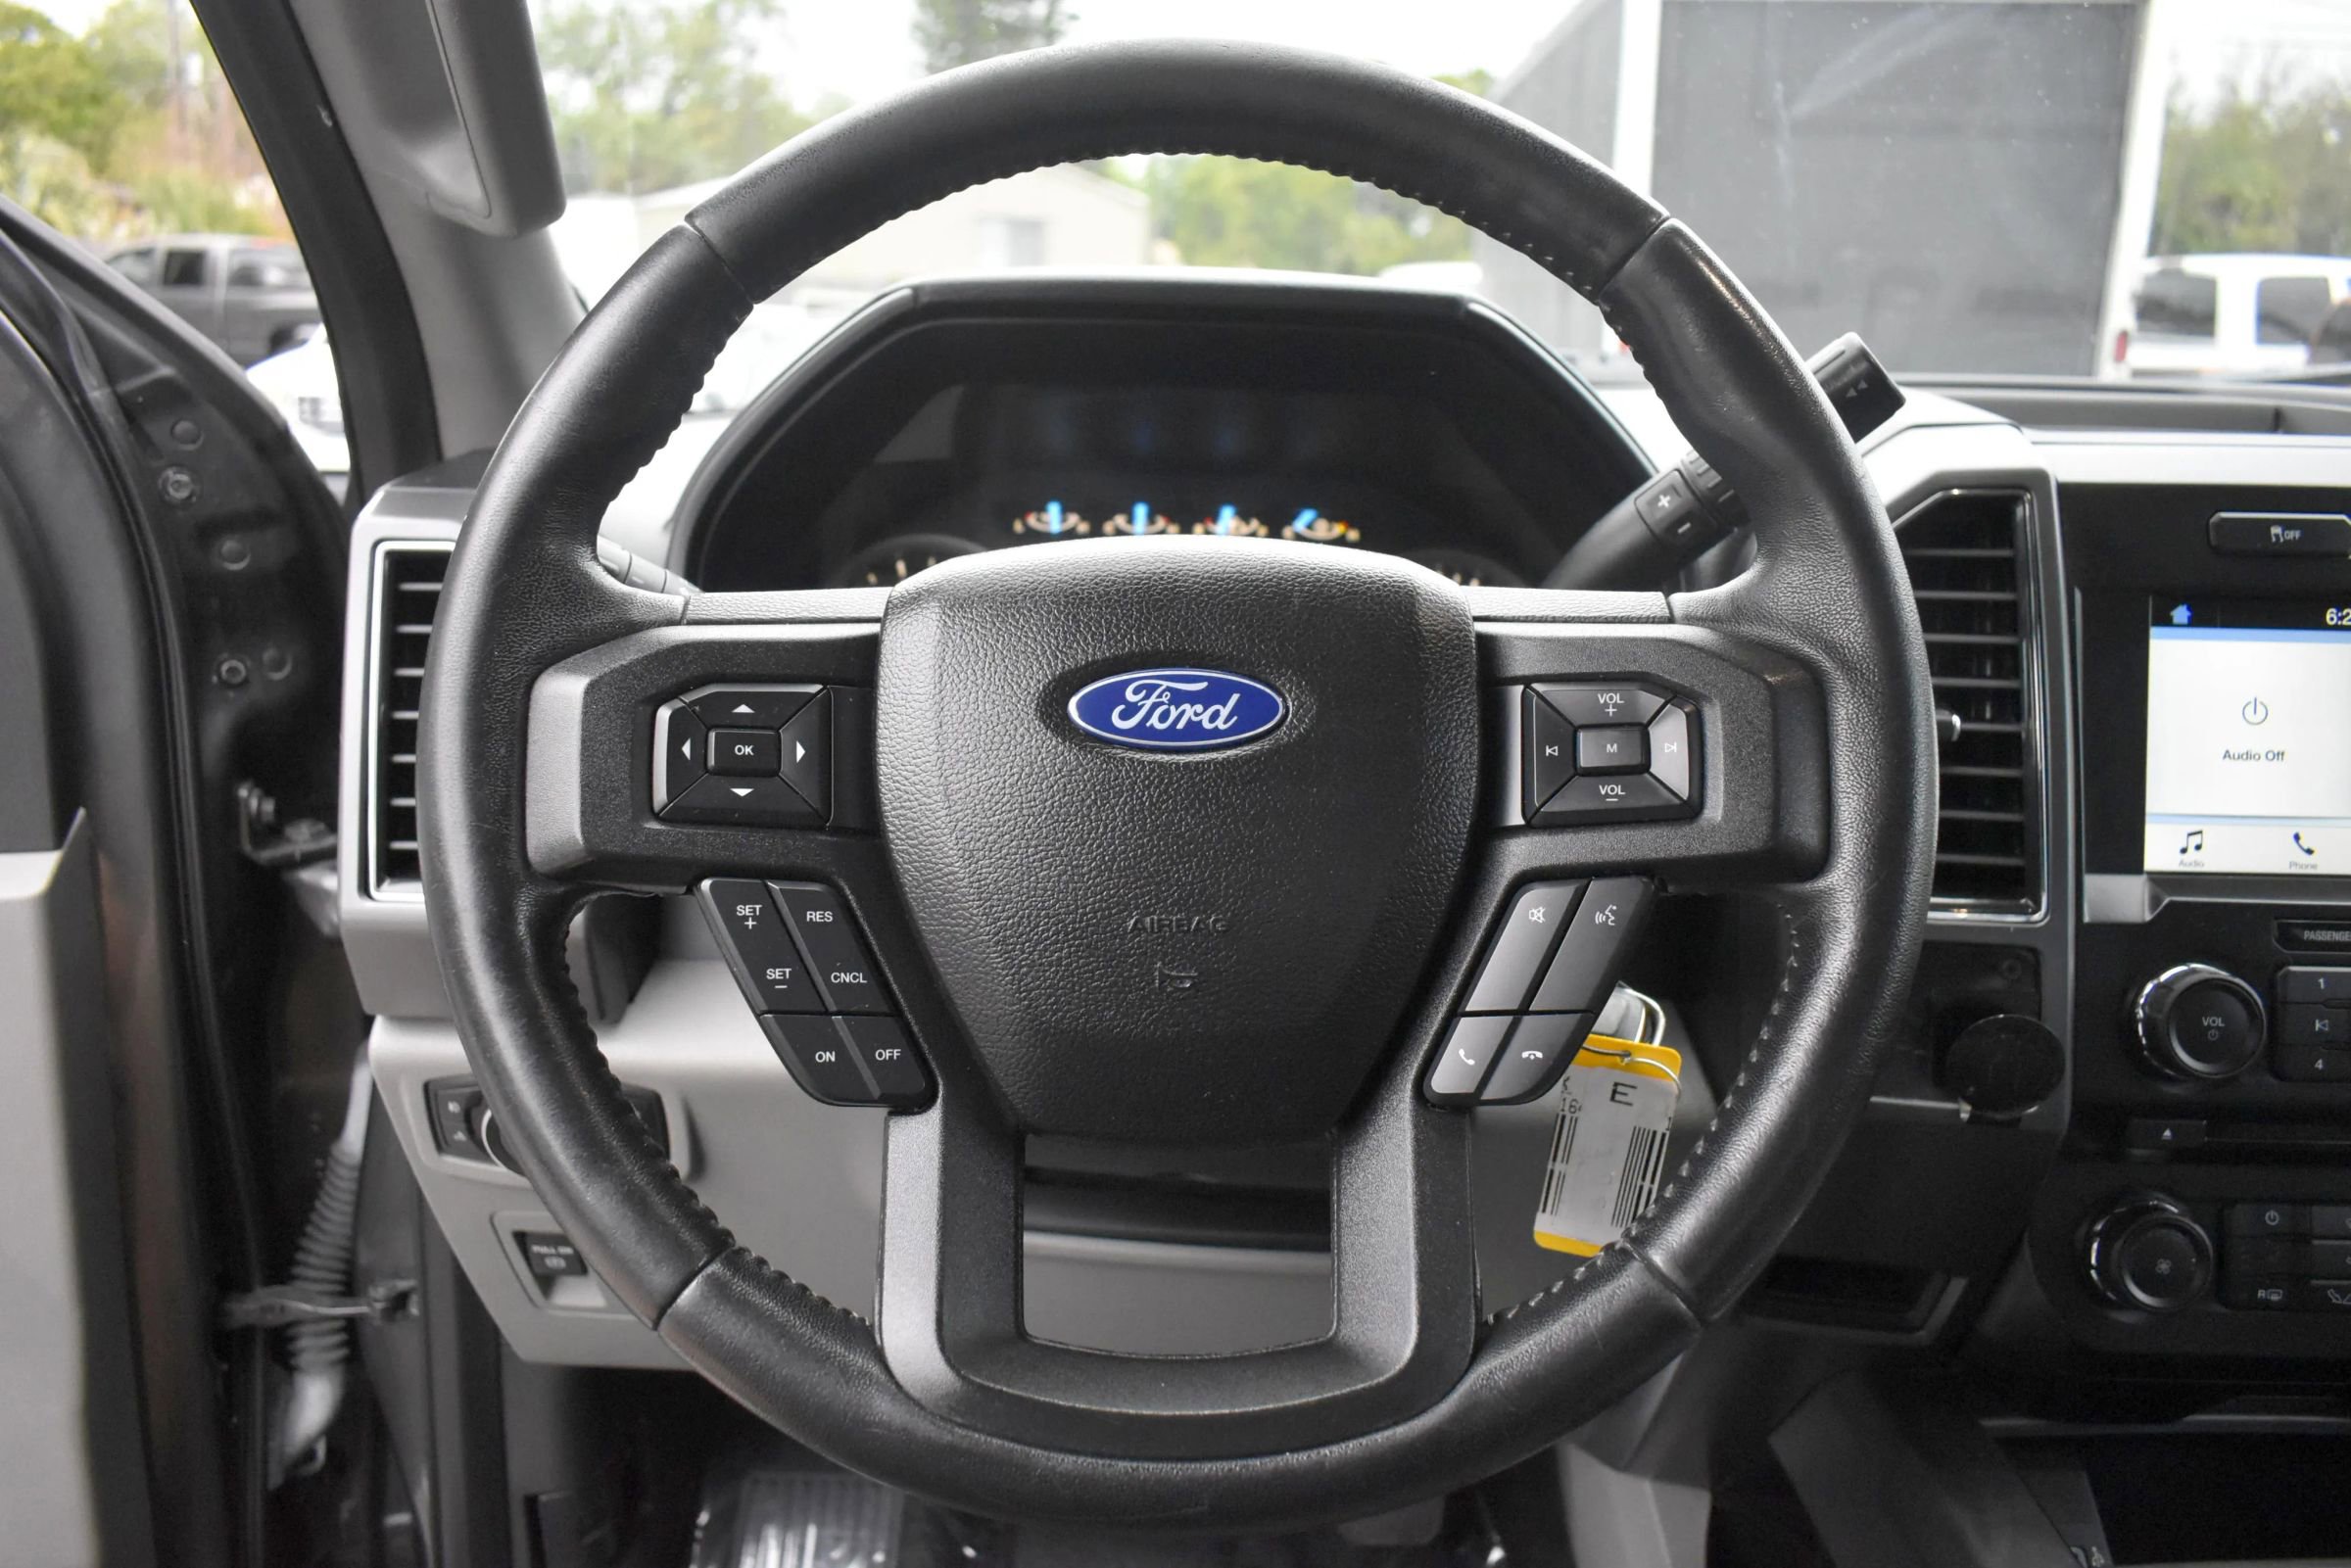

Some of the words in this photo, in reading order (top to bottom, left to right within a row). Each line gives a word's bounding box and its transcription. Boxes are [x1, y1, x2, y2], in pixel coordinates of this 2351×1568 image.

[2283, 530, 2301, 541] OFF
[1597, 692, 1625, 704] VOL
[1111, 679, 1241, 730] Ford
[734, 744, 754, 756] OK
[1606, 742, 1617, 753] M
[2222, 749, 2262, 762] Audio
[2265, 749, 2286, 762] Off
[1599, 784, 1626, 796] VOL
[736, 904, 762, 917] SET
[806, 911, 834, 923] RES
[766, 968, 792, 980] SET
[830, 972, 868, 983] CNCL
[2318, 977, 2325, 989] 1
[2202, 1016, 2226, 1027] VOL
[815, 1051, 836, 1064] ON
[875, 1048, 901, 1061] OFF
[2314, 1059, 2324, 1070] 4
